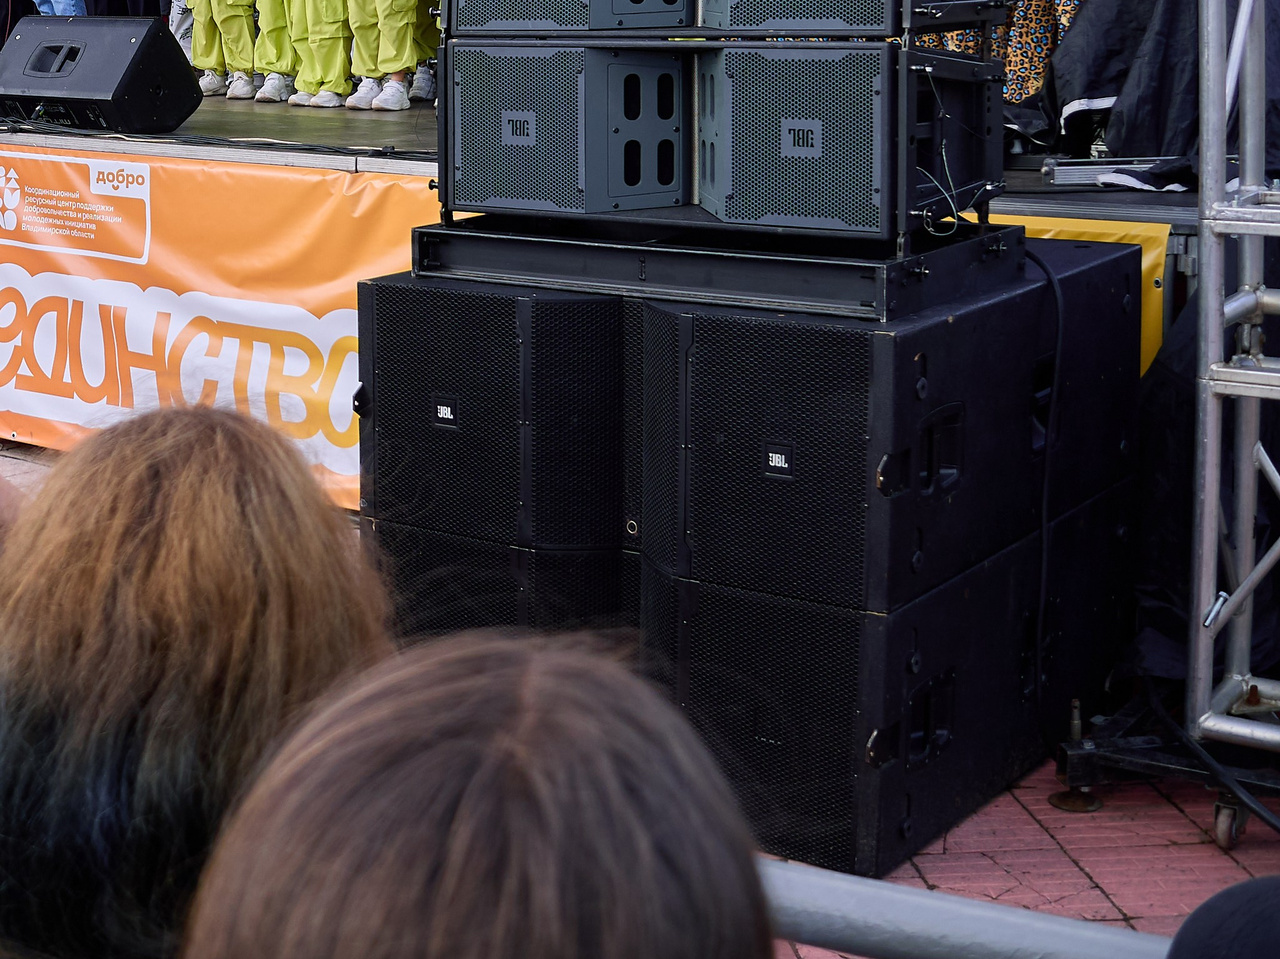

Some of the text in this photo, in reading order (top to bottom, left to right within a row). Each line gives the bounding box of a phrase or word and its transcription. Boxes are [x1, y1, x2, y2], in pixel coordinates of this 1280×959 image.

[507, 119, 530, 137] JBL
[788, 128, 815, 148] JBL
[96, 168, 146, 189] добро
[57, 200, 76, 209] центр
[21, 223, 70, 235] Владимирской
[437, 405, 454, 419] JBL
[768, 452, 789, 468] JBL
